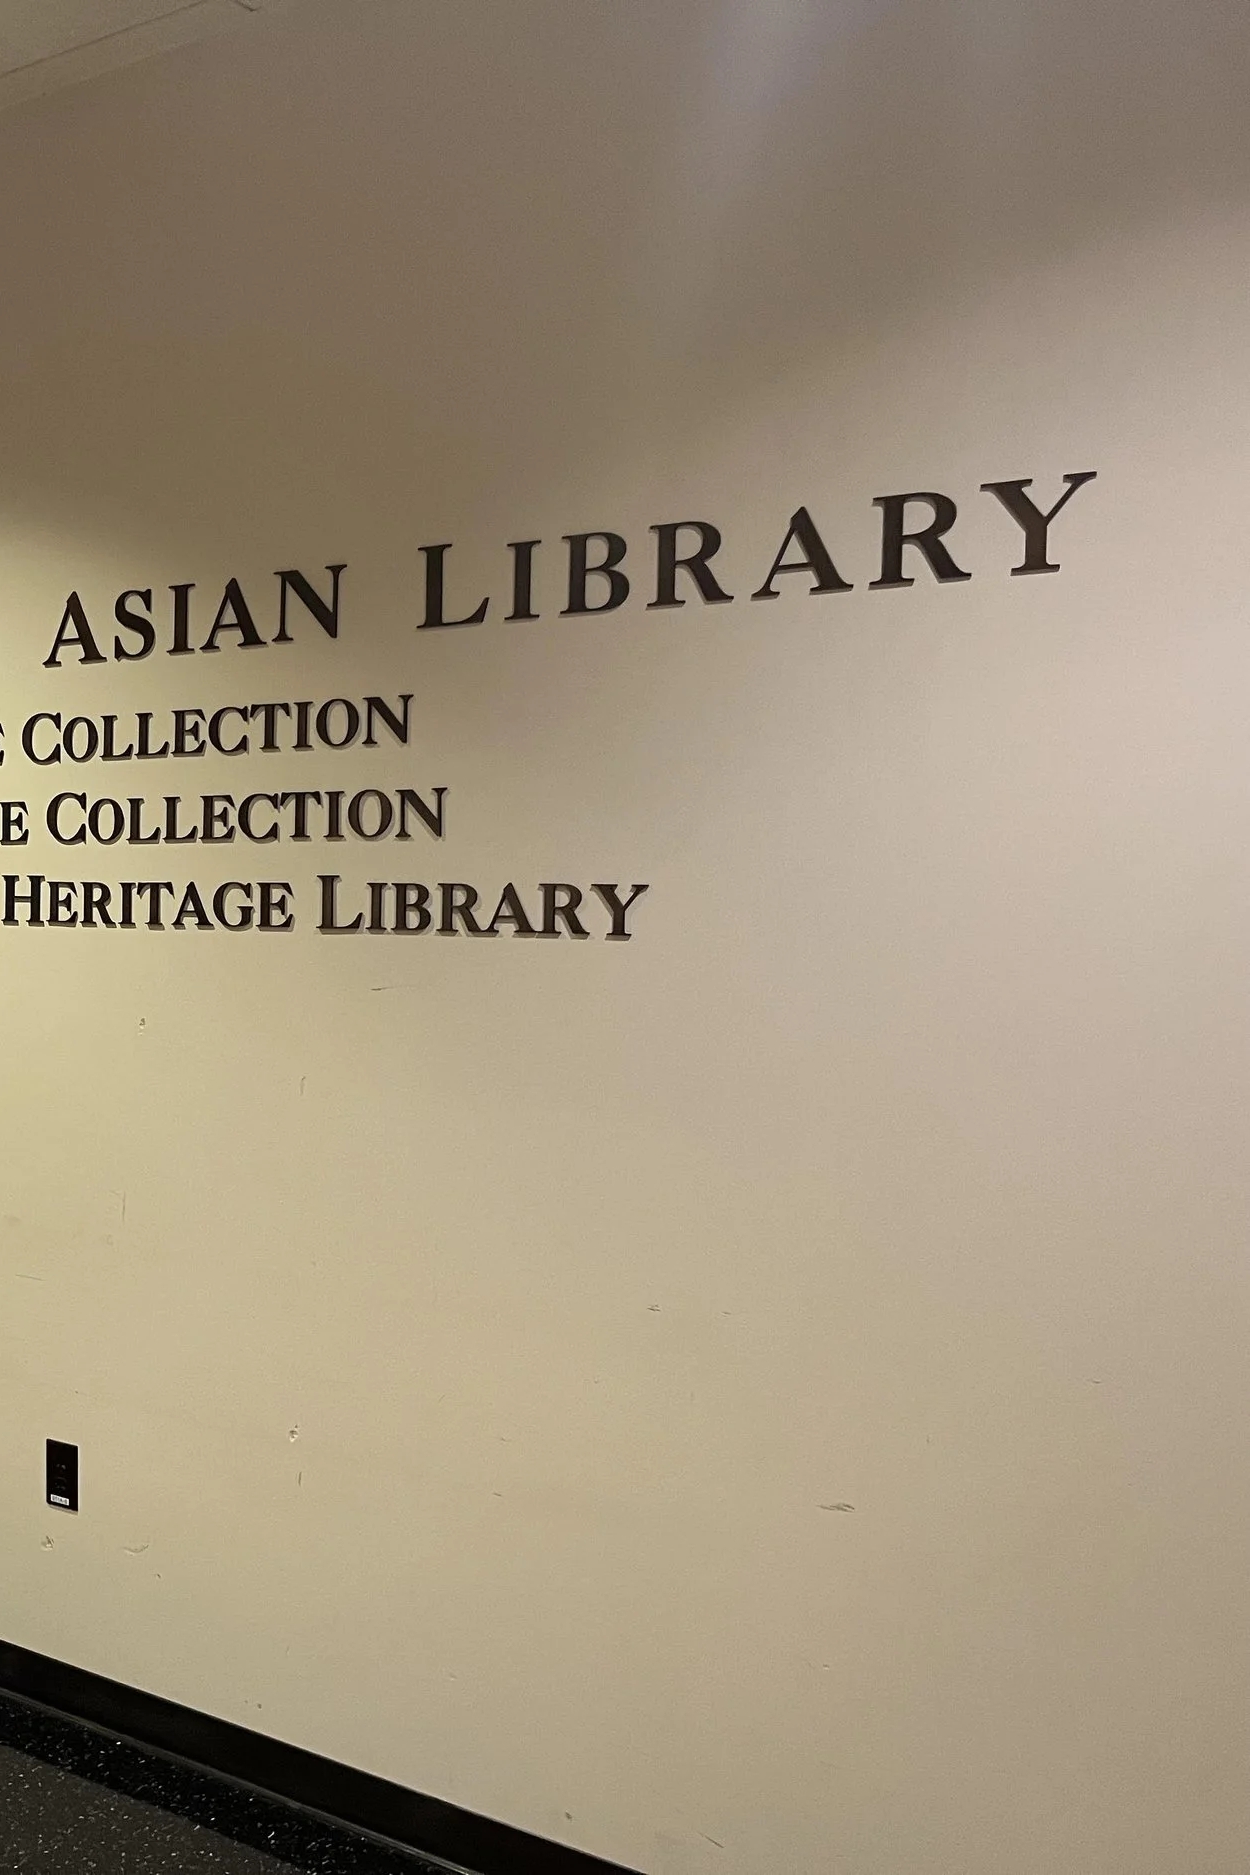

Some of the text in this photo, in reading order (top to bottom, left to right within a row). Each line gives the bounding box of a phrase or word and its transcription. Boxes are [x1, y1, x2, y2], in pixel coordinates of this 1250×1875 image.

[43, 564, 348, 668] ASIAN
[417, 471, 1097, 631] LIBRARY
[22, 694, 414, 765] COLLECTION
[47, 787, 448, 846] COLLECTION
[1, 874, 295, 934] HERITAGE
[316, 875, 649, 942] LIBRARY
